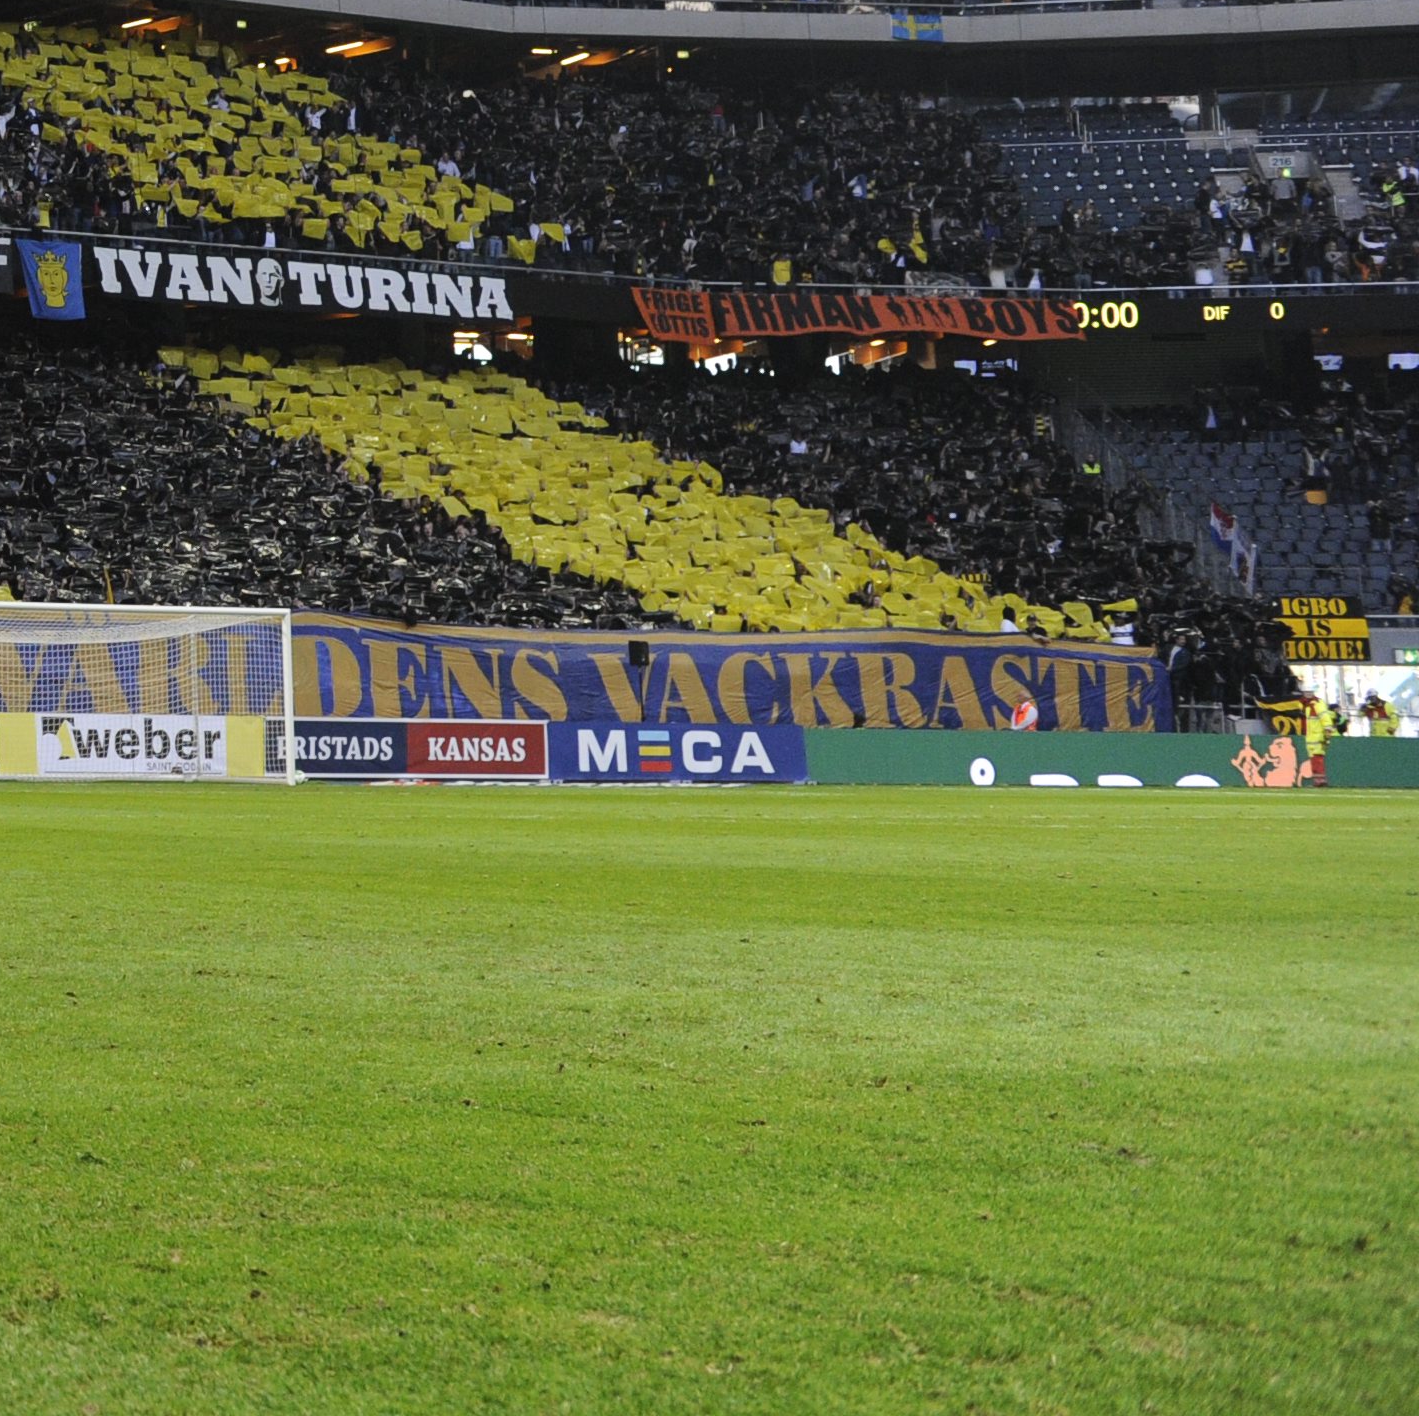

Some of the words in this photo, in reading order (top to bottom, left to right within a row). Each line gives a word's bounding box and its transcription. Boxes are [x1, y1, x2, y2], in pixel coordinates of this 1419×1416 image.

[1271, 157, 1293, 167] 216
[93, 246, 255, 306] IVAN
[288, 260, 514, 321] TURINA
[714, 291, 883, 332] FIRMAN
[962, 298, 1080, 338] BOYS
[1202, 305, 1231, 321] DIF
[1269, 302, 1285, 320] 0
[1280, 597, 1348, 616] IGBO
[1305, 619, 1332, 637] IS
[587, 650, 1155, 733] VACKRASTE
[78, 716, 221, 761] weber
[427, 736, 526, 763] KANSAS
[577, 728, 776, 774] MECA
[146, 761, 212, 772] SAINT-GOBIN
